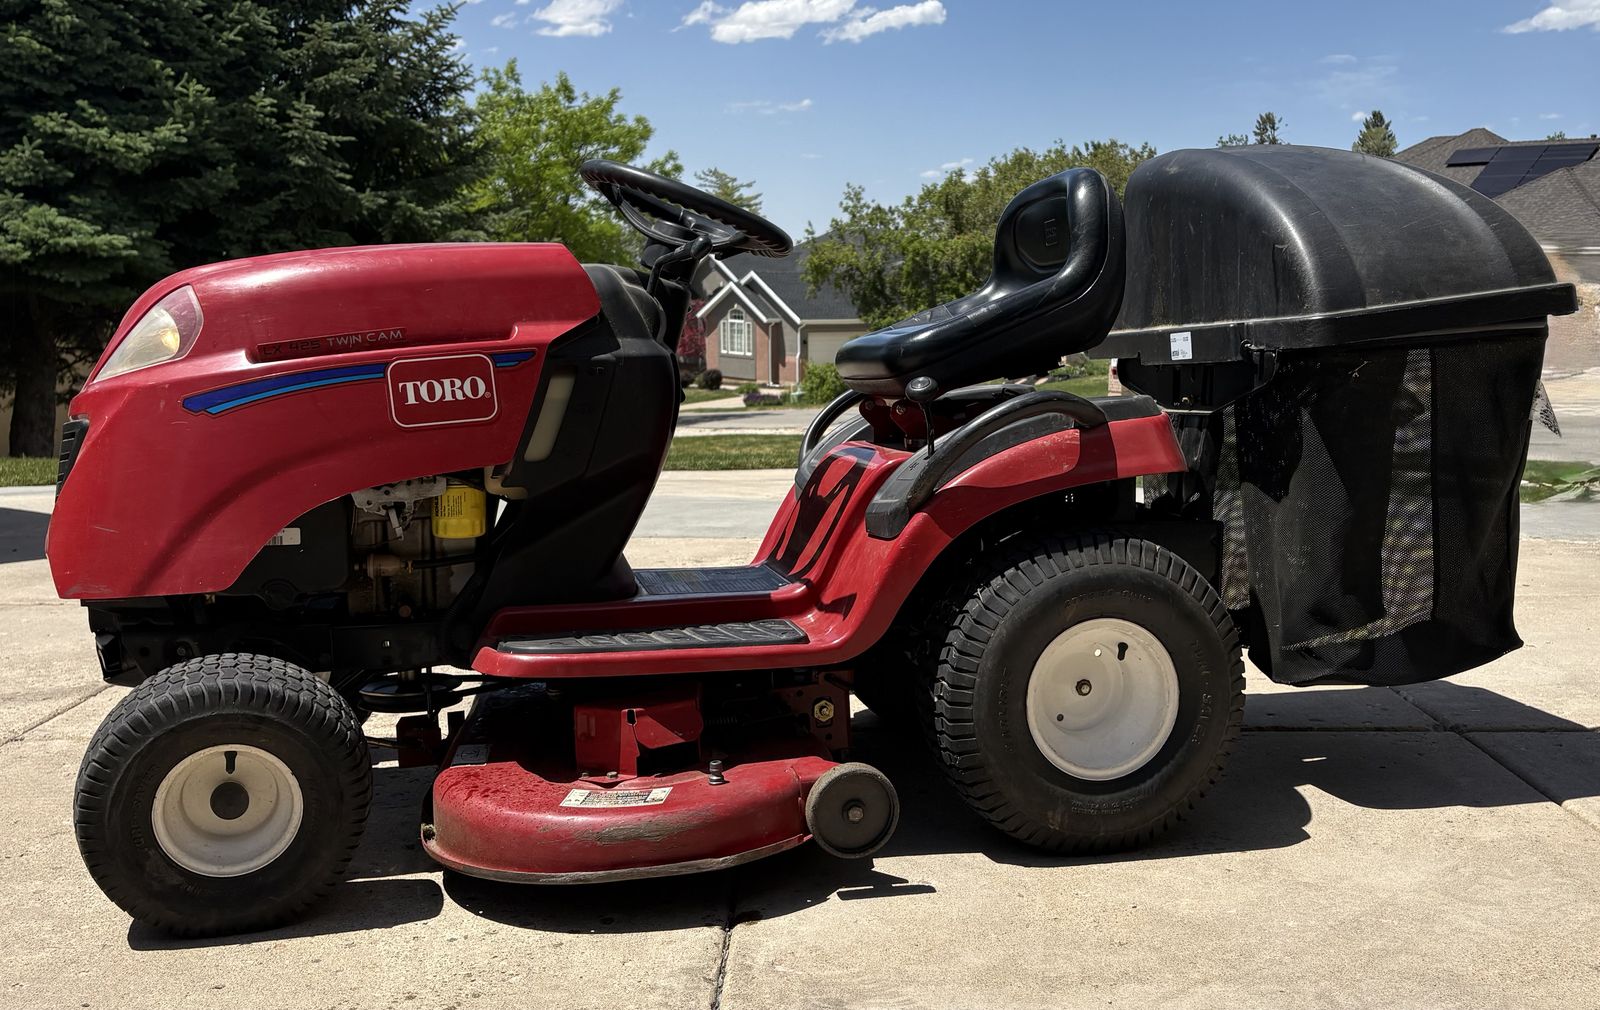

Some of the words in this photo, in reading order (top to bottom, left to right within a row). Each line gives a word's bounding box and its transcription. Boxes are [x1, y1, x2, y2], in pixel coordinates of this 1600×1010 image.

[262, 345, 281, 356] LX
[326, 333, 362, 348] TWIN
[366, 329, 402, 342] CAM
[398, 376, 486, 405] TORO
